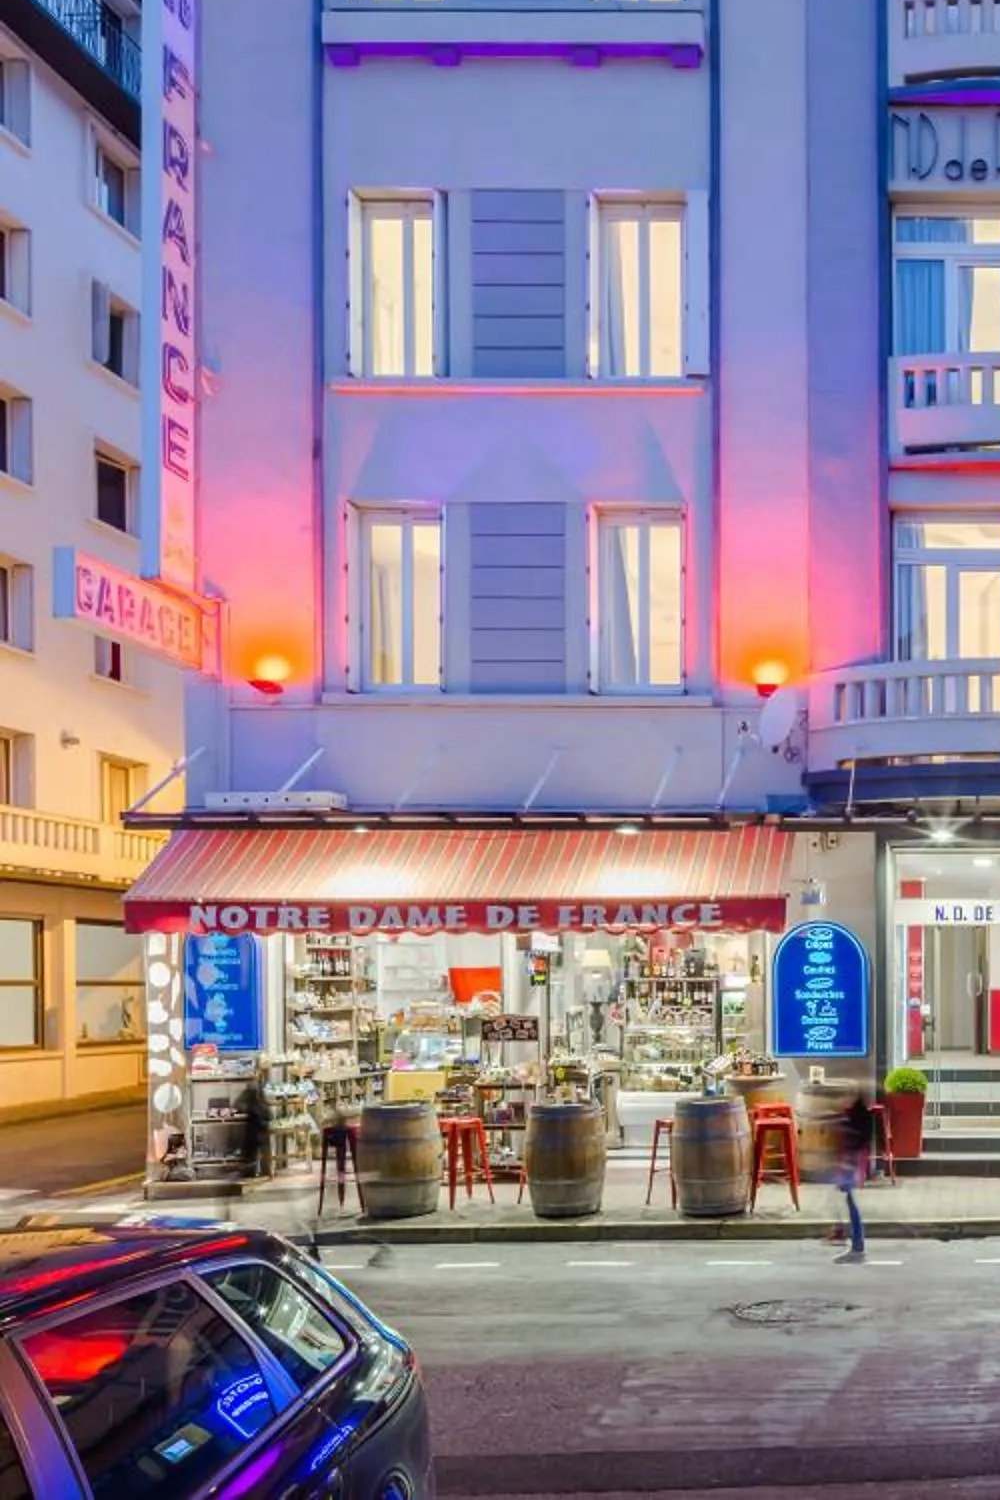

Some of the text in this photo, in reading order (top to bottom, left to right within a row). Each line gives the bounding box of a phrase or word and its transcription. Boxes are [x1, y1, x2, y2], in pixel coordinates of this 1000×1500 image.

[162, 44, 195, 482] FRANCE
[76, 564, 192, 652] GARAGE
[189, 902, 723, 930] NOTRE DAME DE FRANCE
[974, 905, 994, 921] DE
